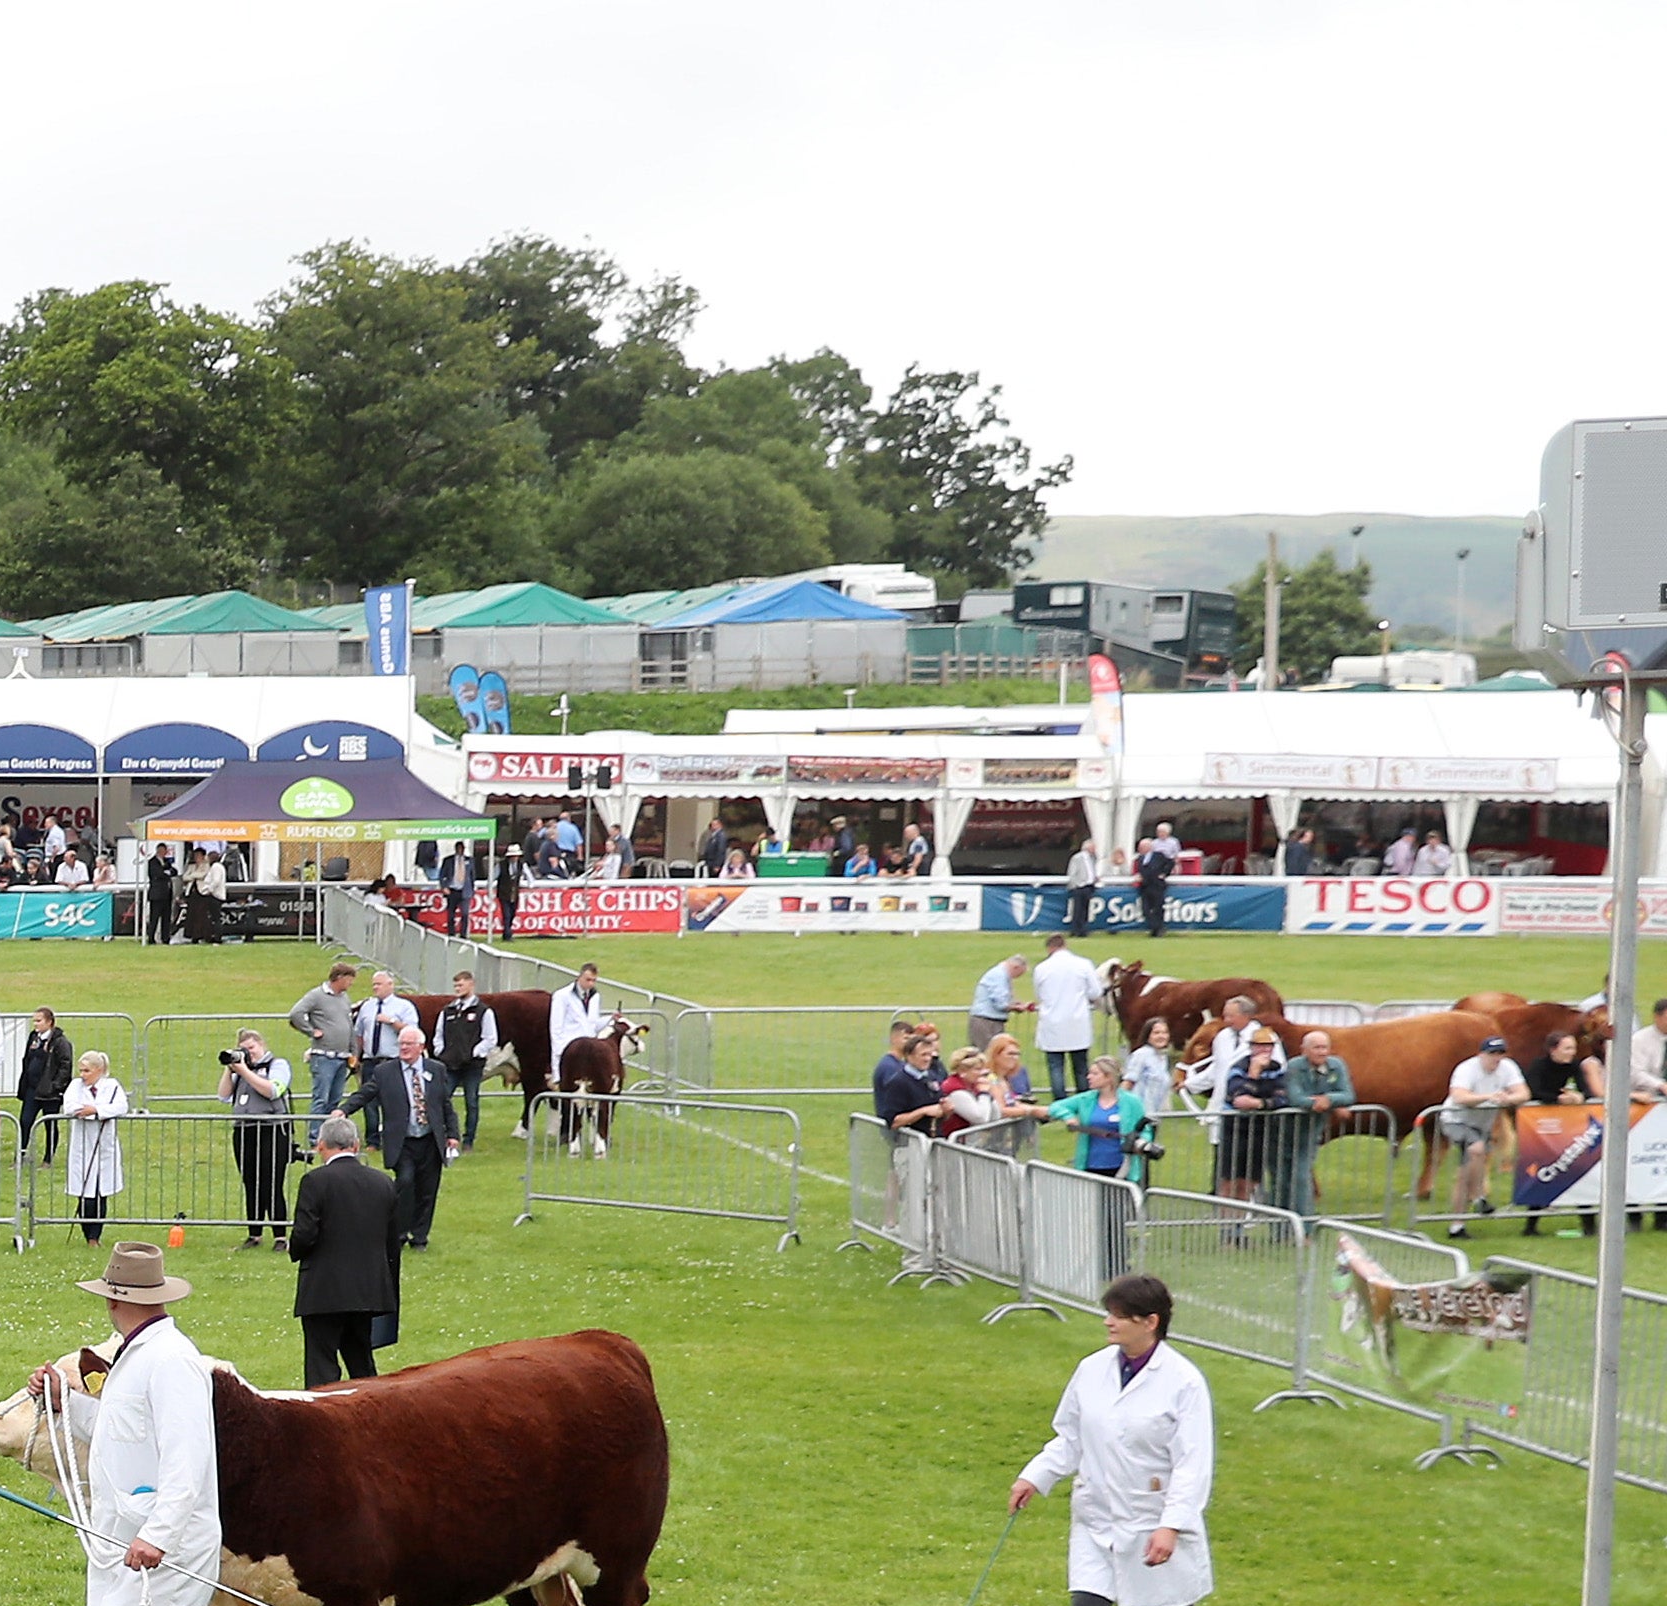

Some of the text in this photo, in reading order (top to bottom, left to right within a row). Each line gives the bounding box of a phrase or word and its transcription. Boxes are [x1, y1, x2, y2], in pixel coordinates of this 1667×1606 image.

[11, 759, 47, 769] Genetic
[49, 759, 93, 771] Progress
[287, 825, 356, 838] RUMENCO
[517, 889, 679, 912] ISH & CHIPS
[1303, 880, 1492, 912] TESCO
[44, 903, 96, 928] S4C
[1061, 897, 1218, 923] JP Solitors
[472, 916, 521, 930] YEAS
[523, 916, 544, 930] OF
[545, 916, 622, 931] QUALITY
